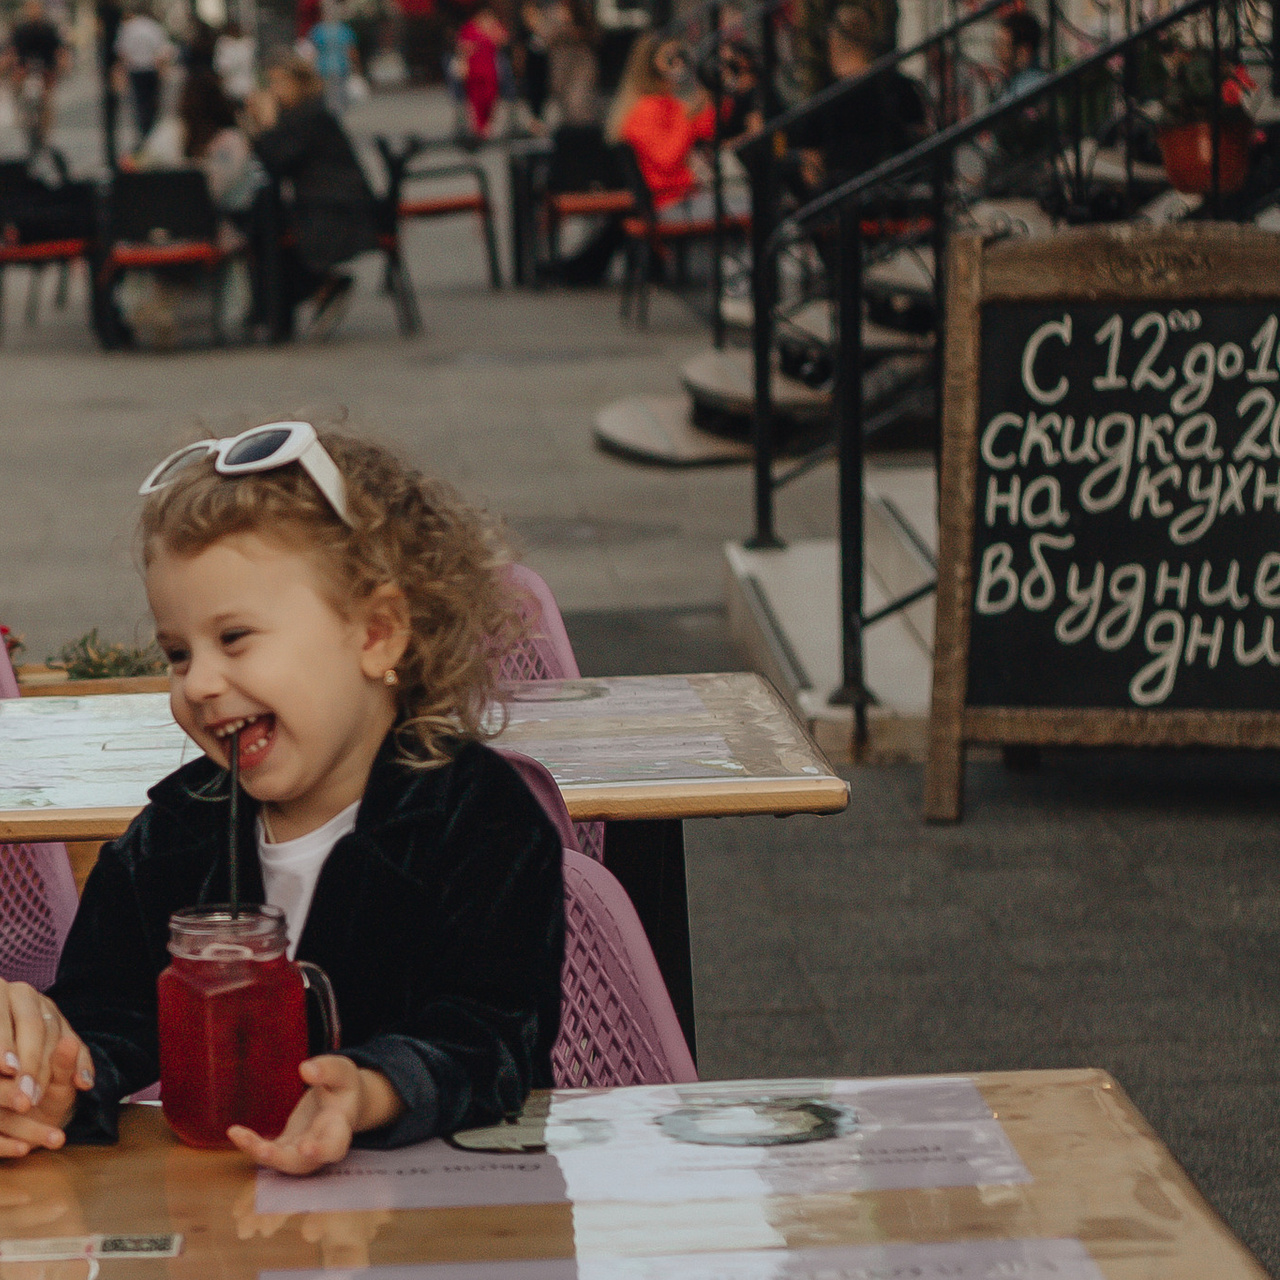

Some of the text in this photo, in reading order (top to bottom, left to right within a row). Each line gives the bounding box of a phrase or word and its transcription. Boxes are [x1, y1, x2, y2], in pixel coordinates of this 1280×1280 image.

[1022, 312, 1073, 406] С
[1244, 313, 1280, 384] 1
[981, 411, 1224, 514] скидка
[985, 473, 1071, 530] на
